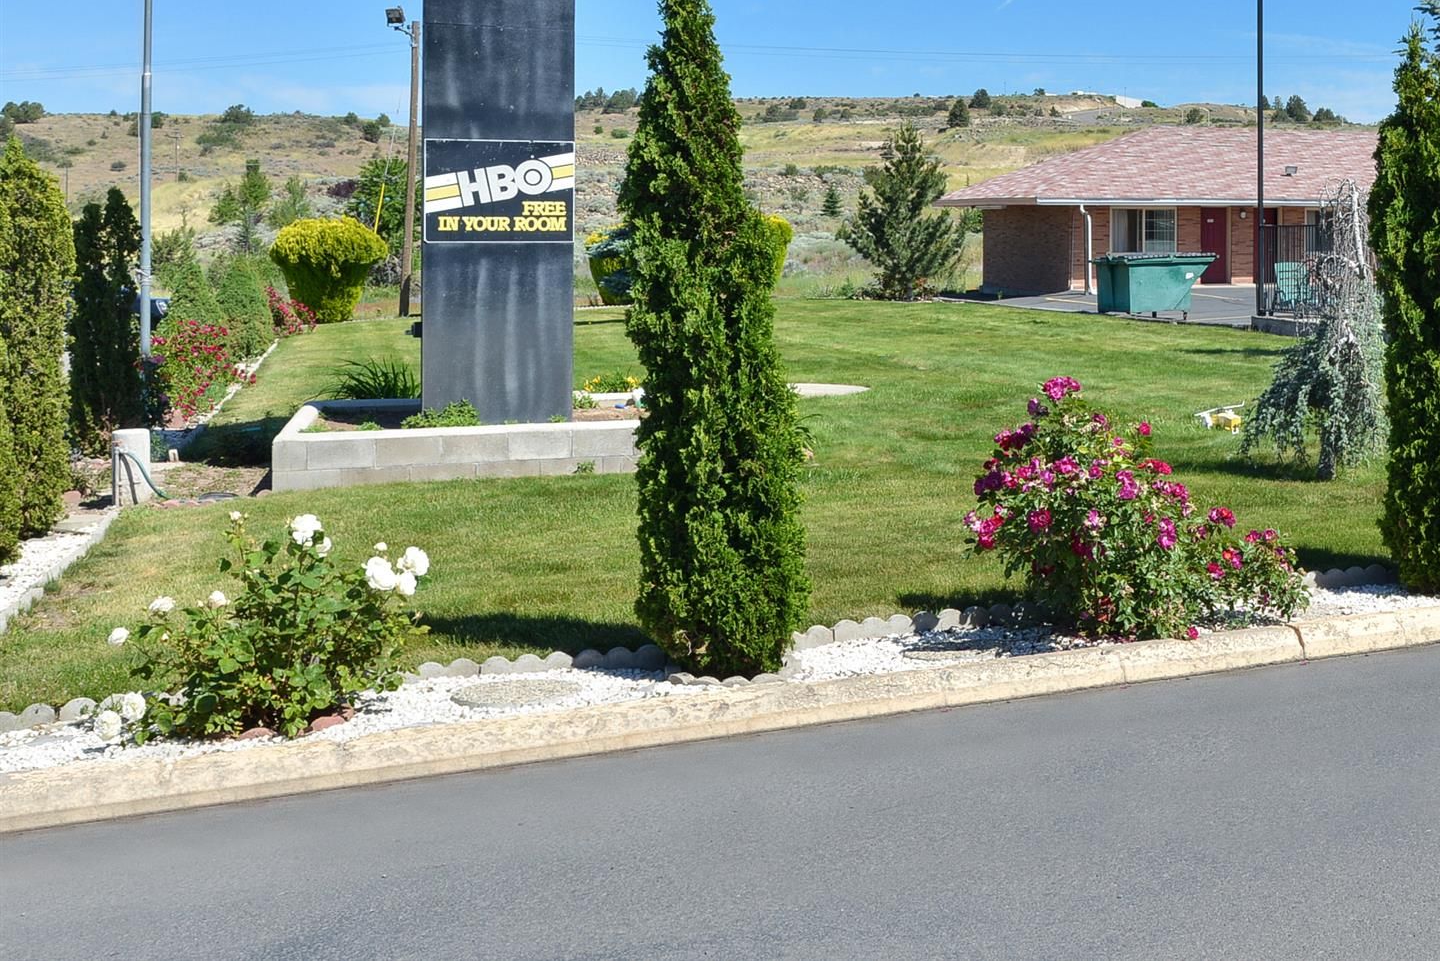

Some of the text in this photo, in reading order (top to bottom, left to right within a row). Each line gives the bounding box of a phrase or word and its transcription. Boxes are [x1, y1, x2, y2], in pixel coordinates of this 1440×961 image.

[457, 159, 552, 207] HBO
[522, 201, 567, 216] FREE
[438, 216, 567, 232] IN YOUR ROOM
